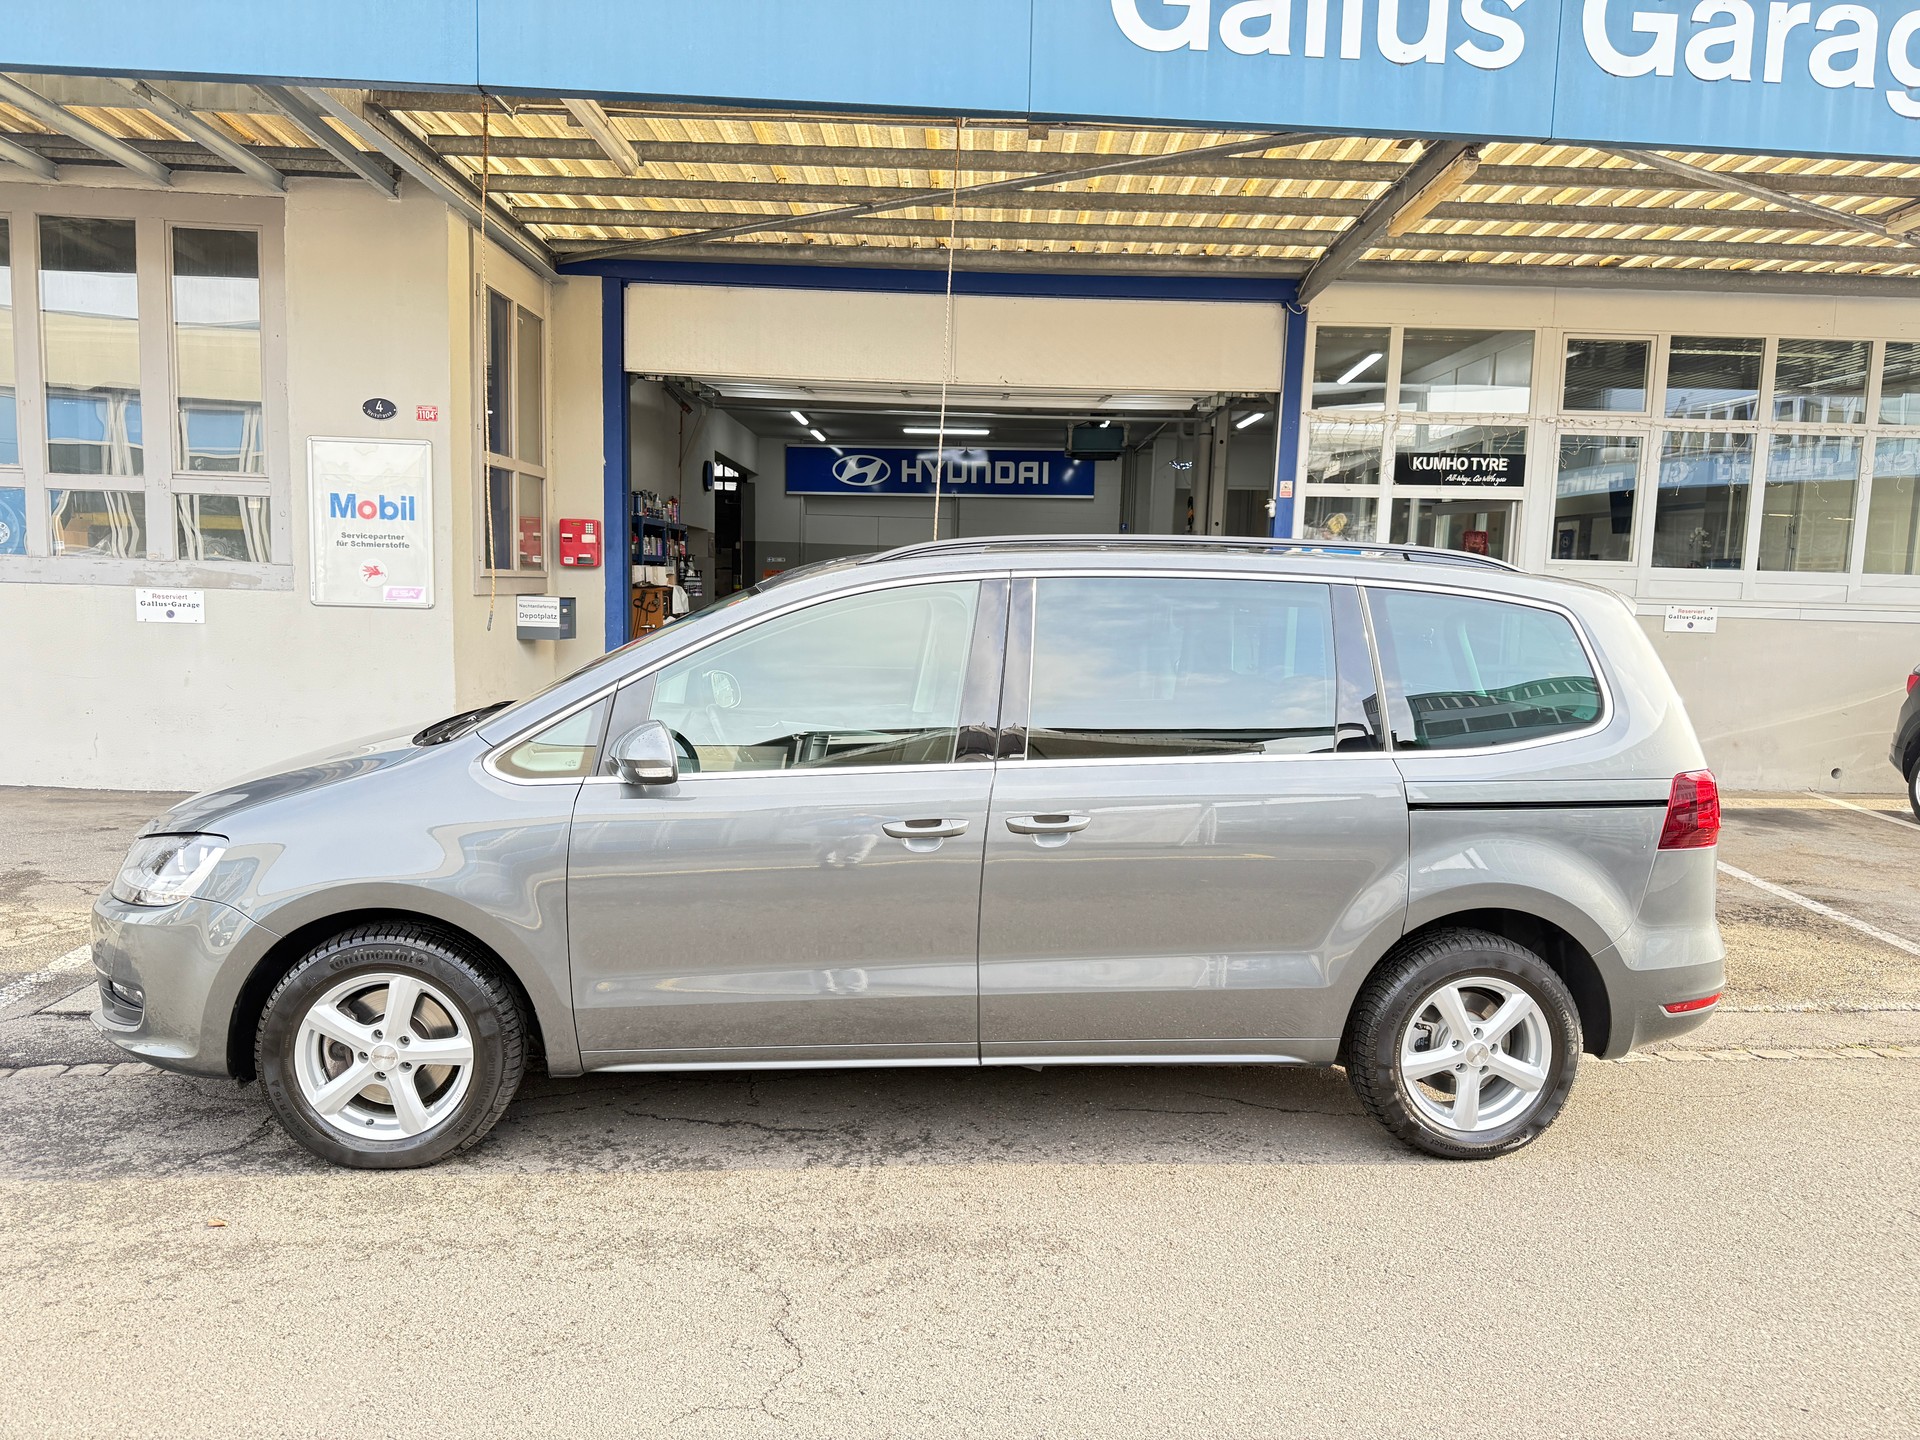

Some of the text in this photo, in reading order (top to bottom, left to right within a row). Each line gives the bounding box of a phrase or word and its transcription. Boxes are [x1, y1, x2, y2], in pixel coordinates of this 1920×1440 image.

[375, 400, 384, 413] 4
[418, 410, 436, 420] 1104
[1412, 456, 1508, 471] KUMHO TYRE
[901, 459, 1049, 485] HYUNDAI
[329, 492, 415, 521] Mobil
[341, 531, 405, 541] Servicepartner
[350, 540, 410, 549] Schmierstoffe
[151, 592, 188, 600] Reserviert
[140, 600, 200, 609] Gallus-Garage
[519, 612, 558, 620] Depotplatz
